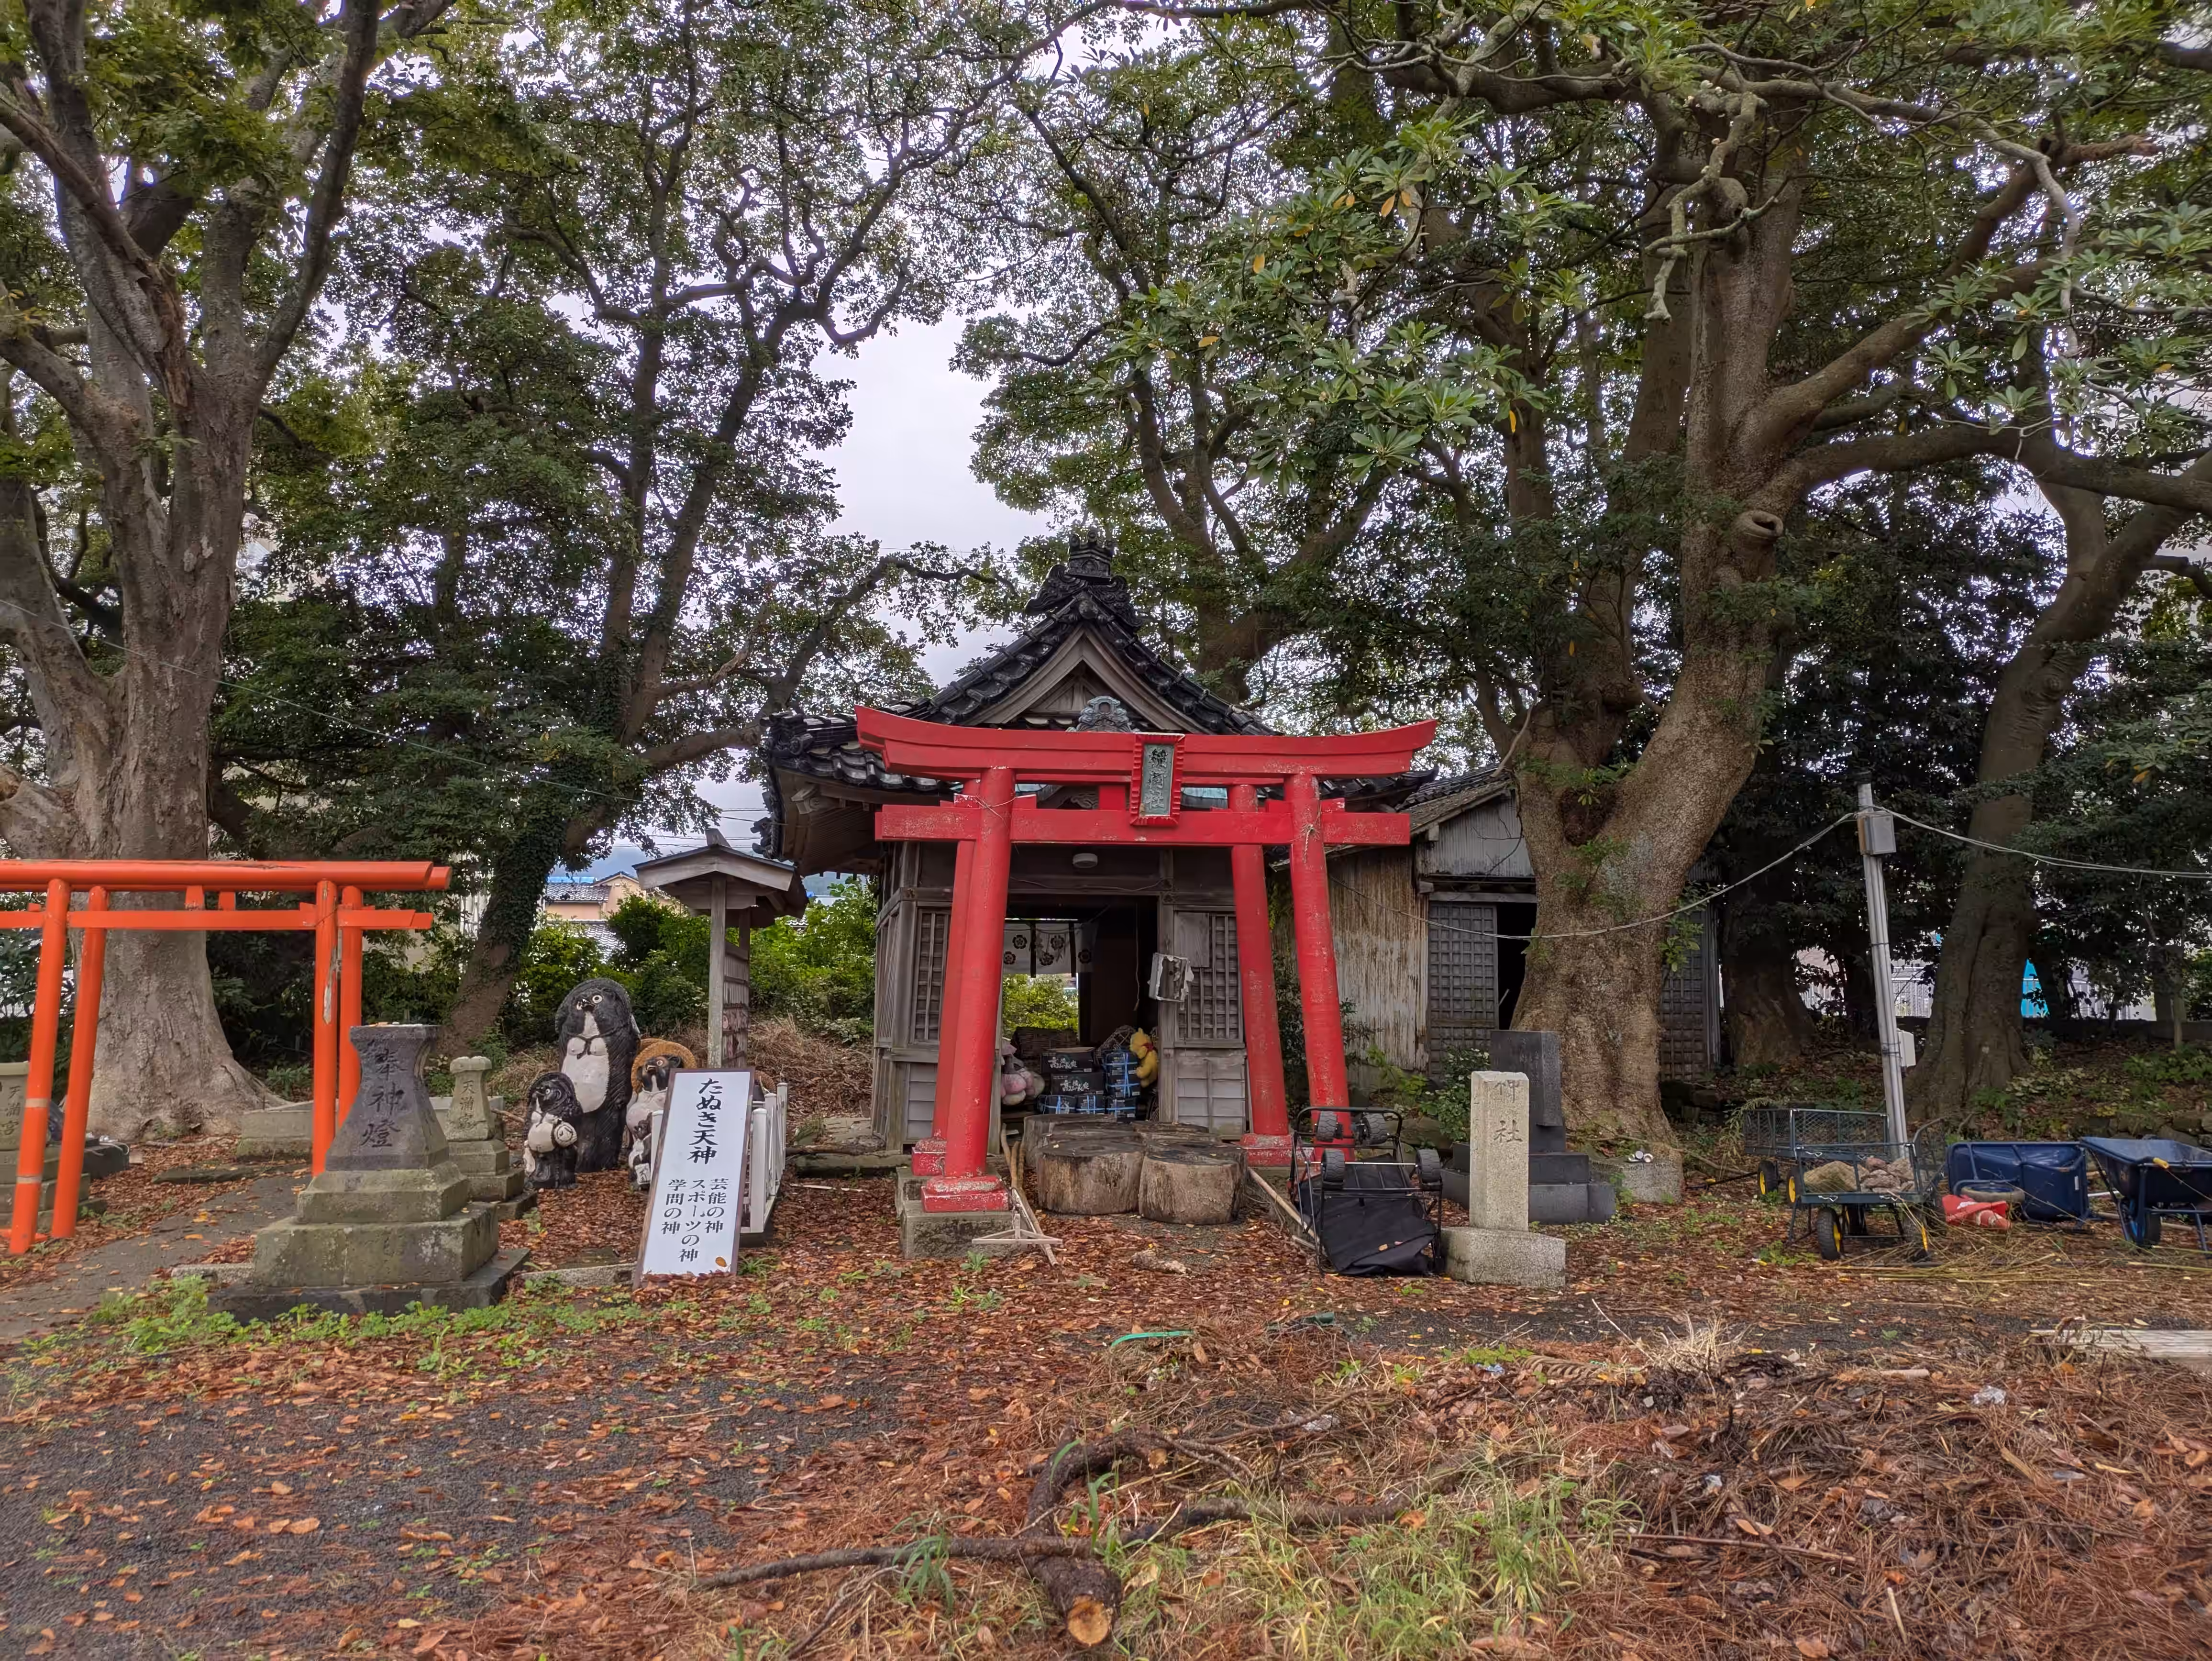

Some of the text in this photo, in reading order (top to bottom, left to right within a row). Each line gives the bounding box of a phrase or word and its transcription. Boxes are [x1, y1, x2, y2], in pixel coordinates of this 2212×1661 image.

[687, 1078, 723, 1165] たぬき天神
[661, 1179, 687, 1235] 学問の神
[678, 1178, 706, 1262] スポーツの神
[704, 1178, 729, 1234] 芸能の神
